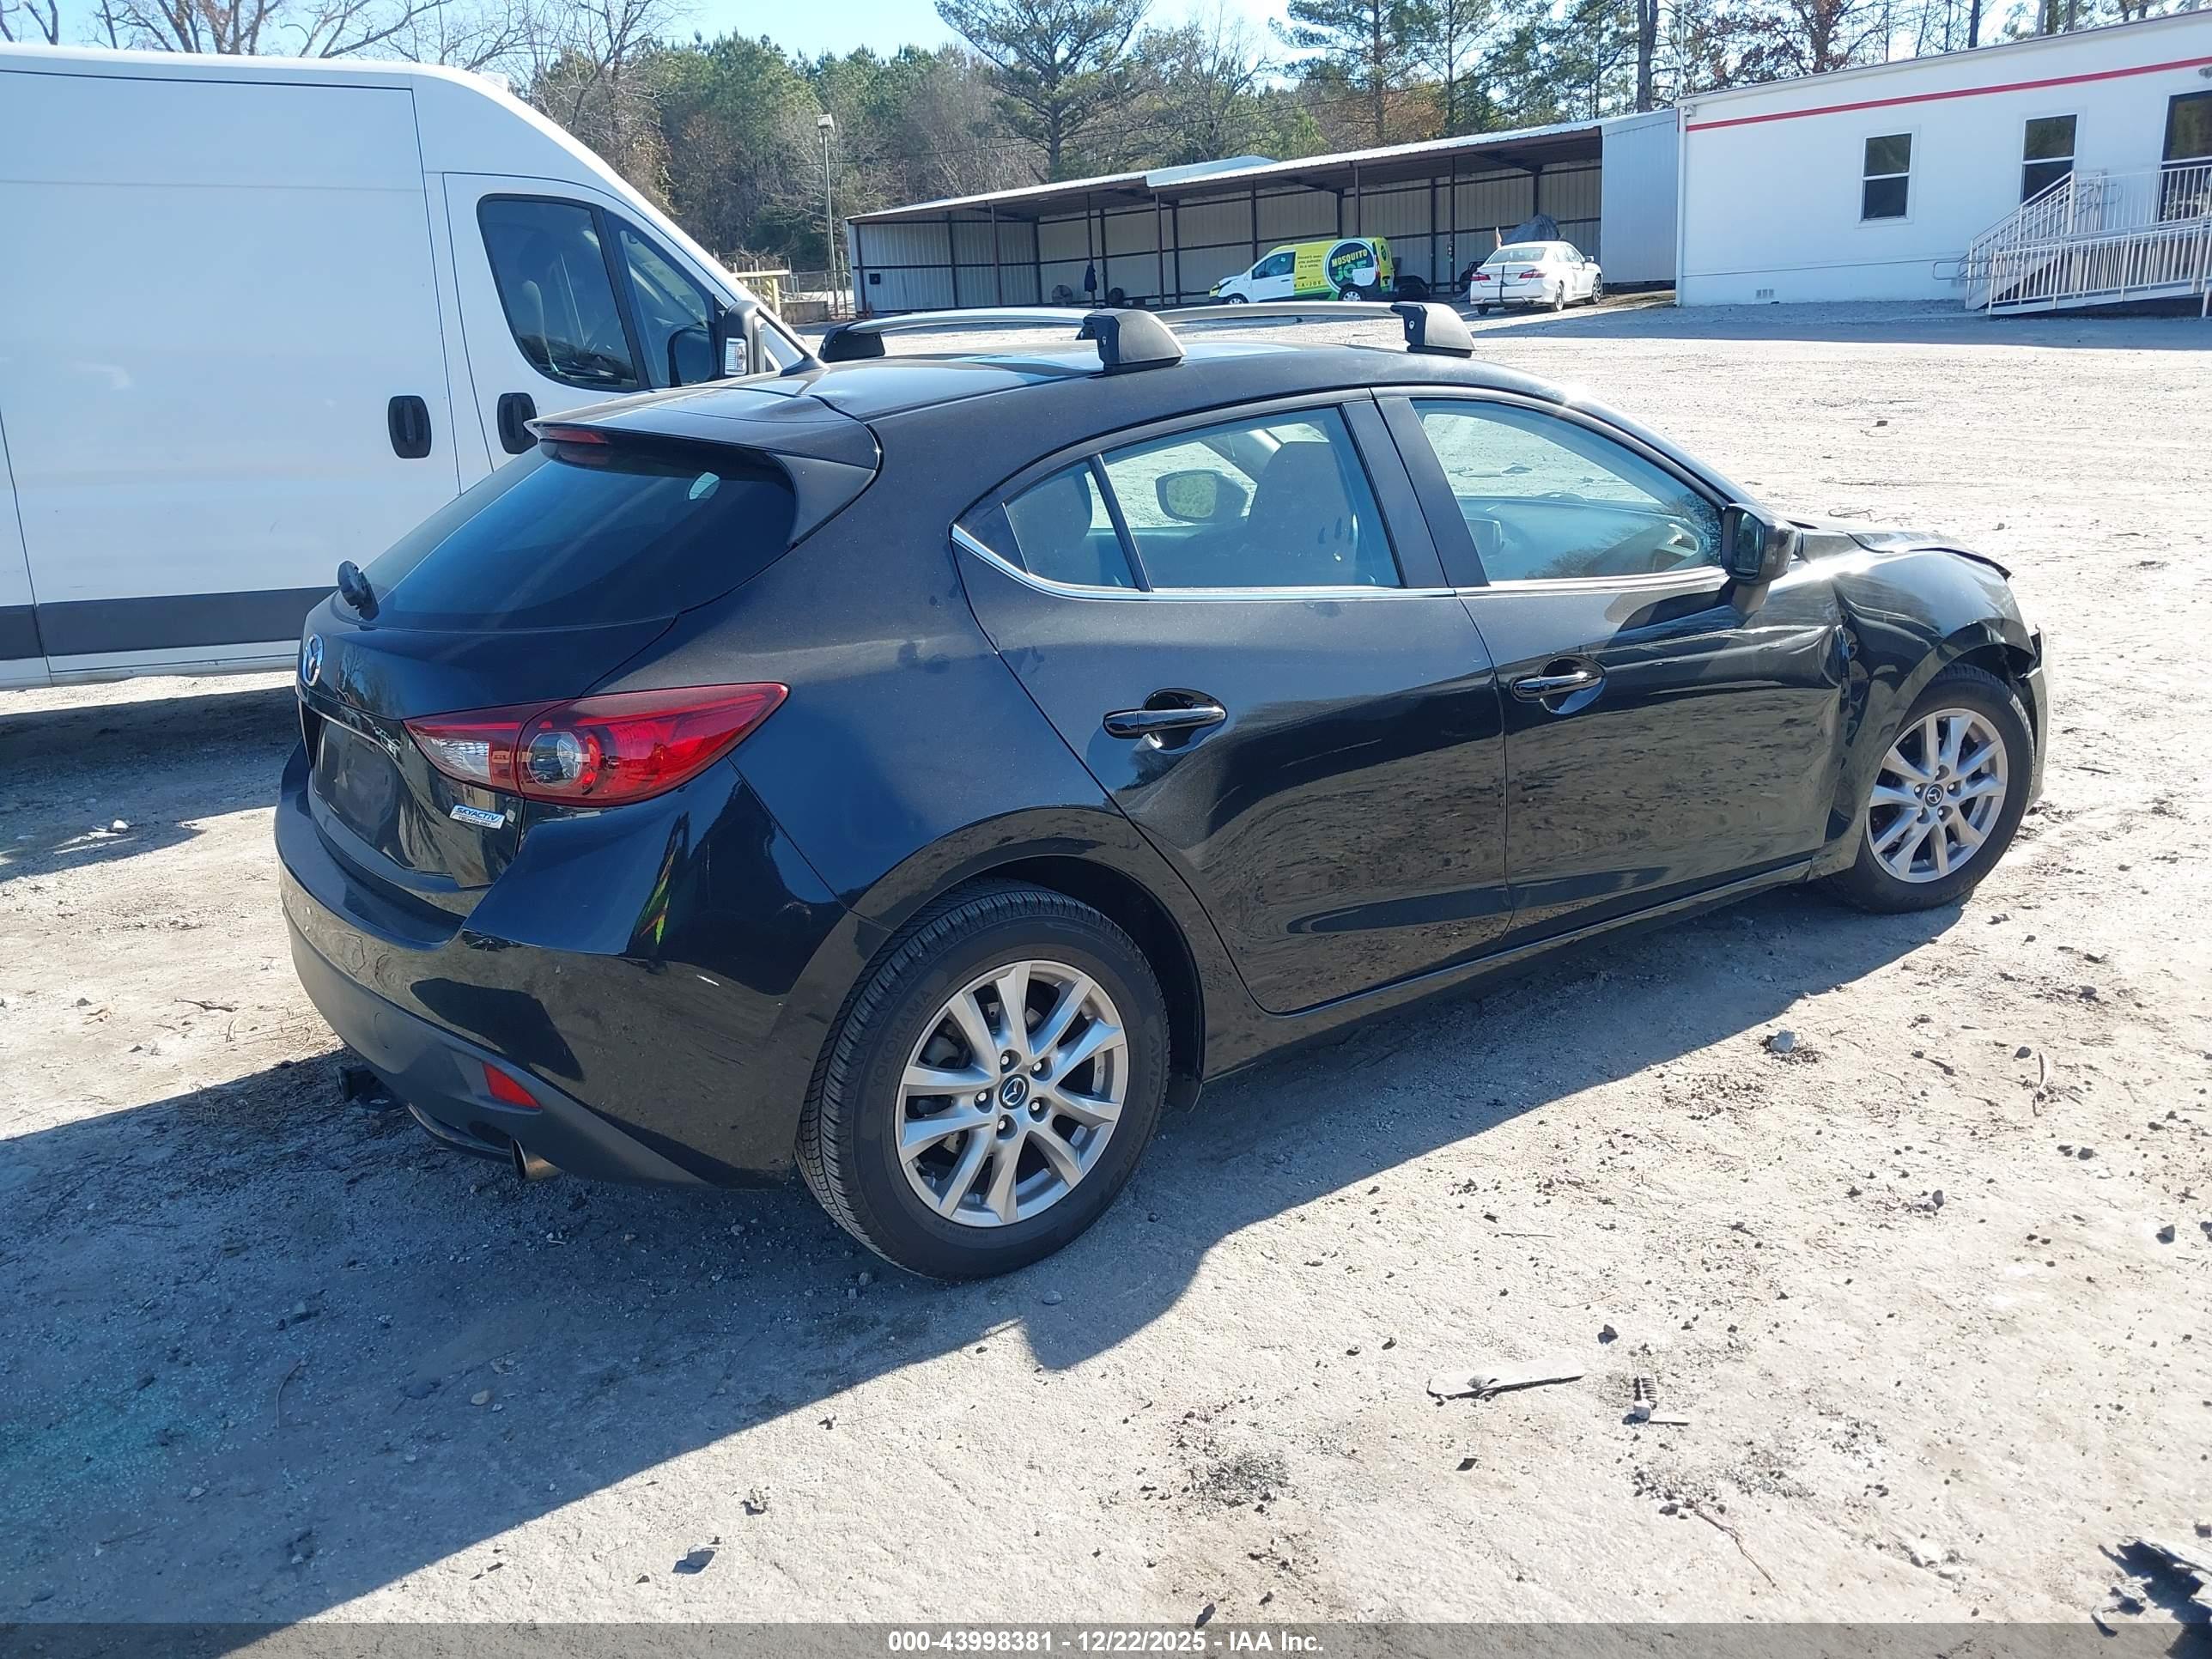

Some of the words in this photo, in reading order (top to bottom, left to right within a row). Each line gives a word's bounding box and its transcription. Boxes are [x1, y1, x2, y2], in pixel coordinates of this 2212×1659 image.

[1331, 248, 1368, 267] MOSQUITO
[456, 807, 498, 821] SKYACTIV
[871, 989, 933, 1085] YOKOHAMA
